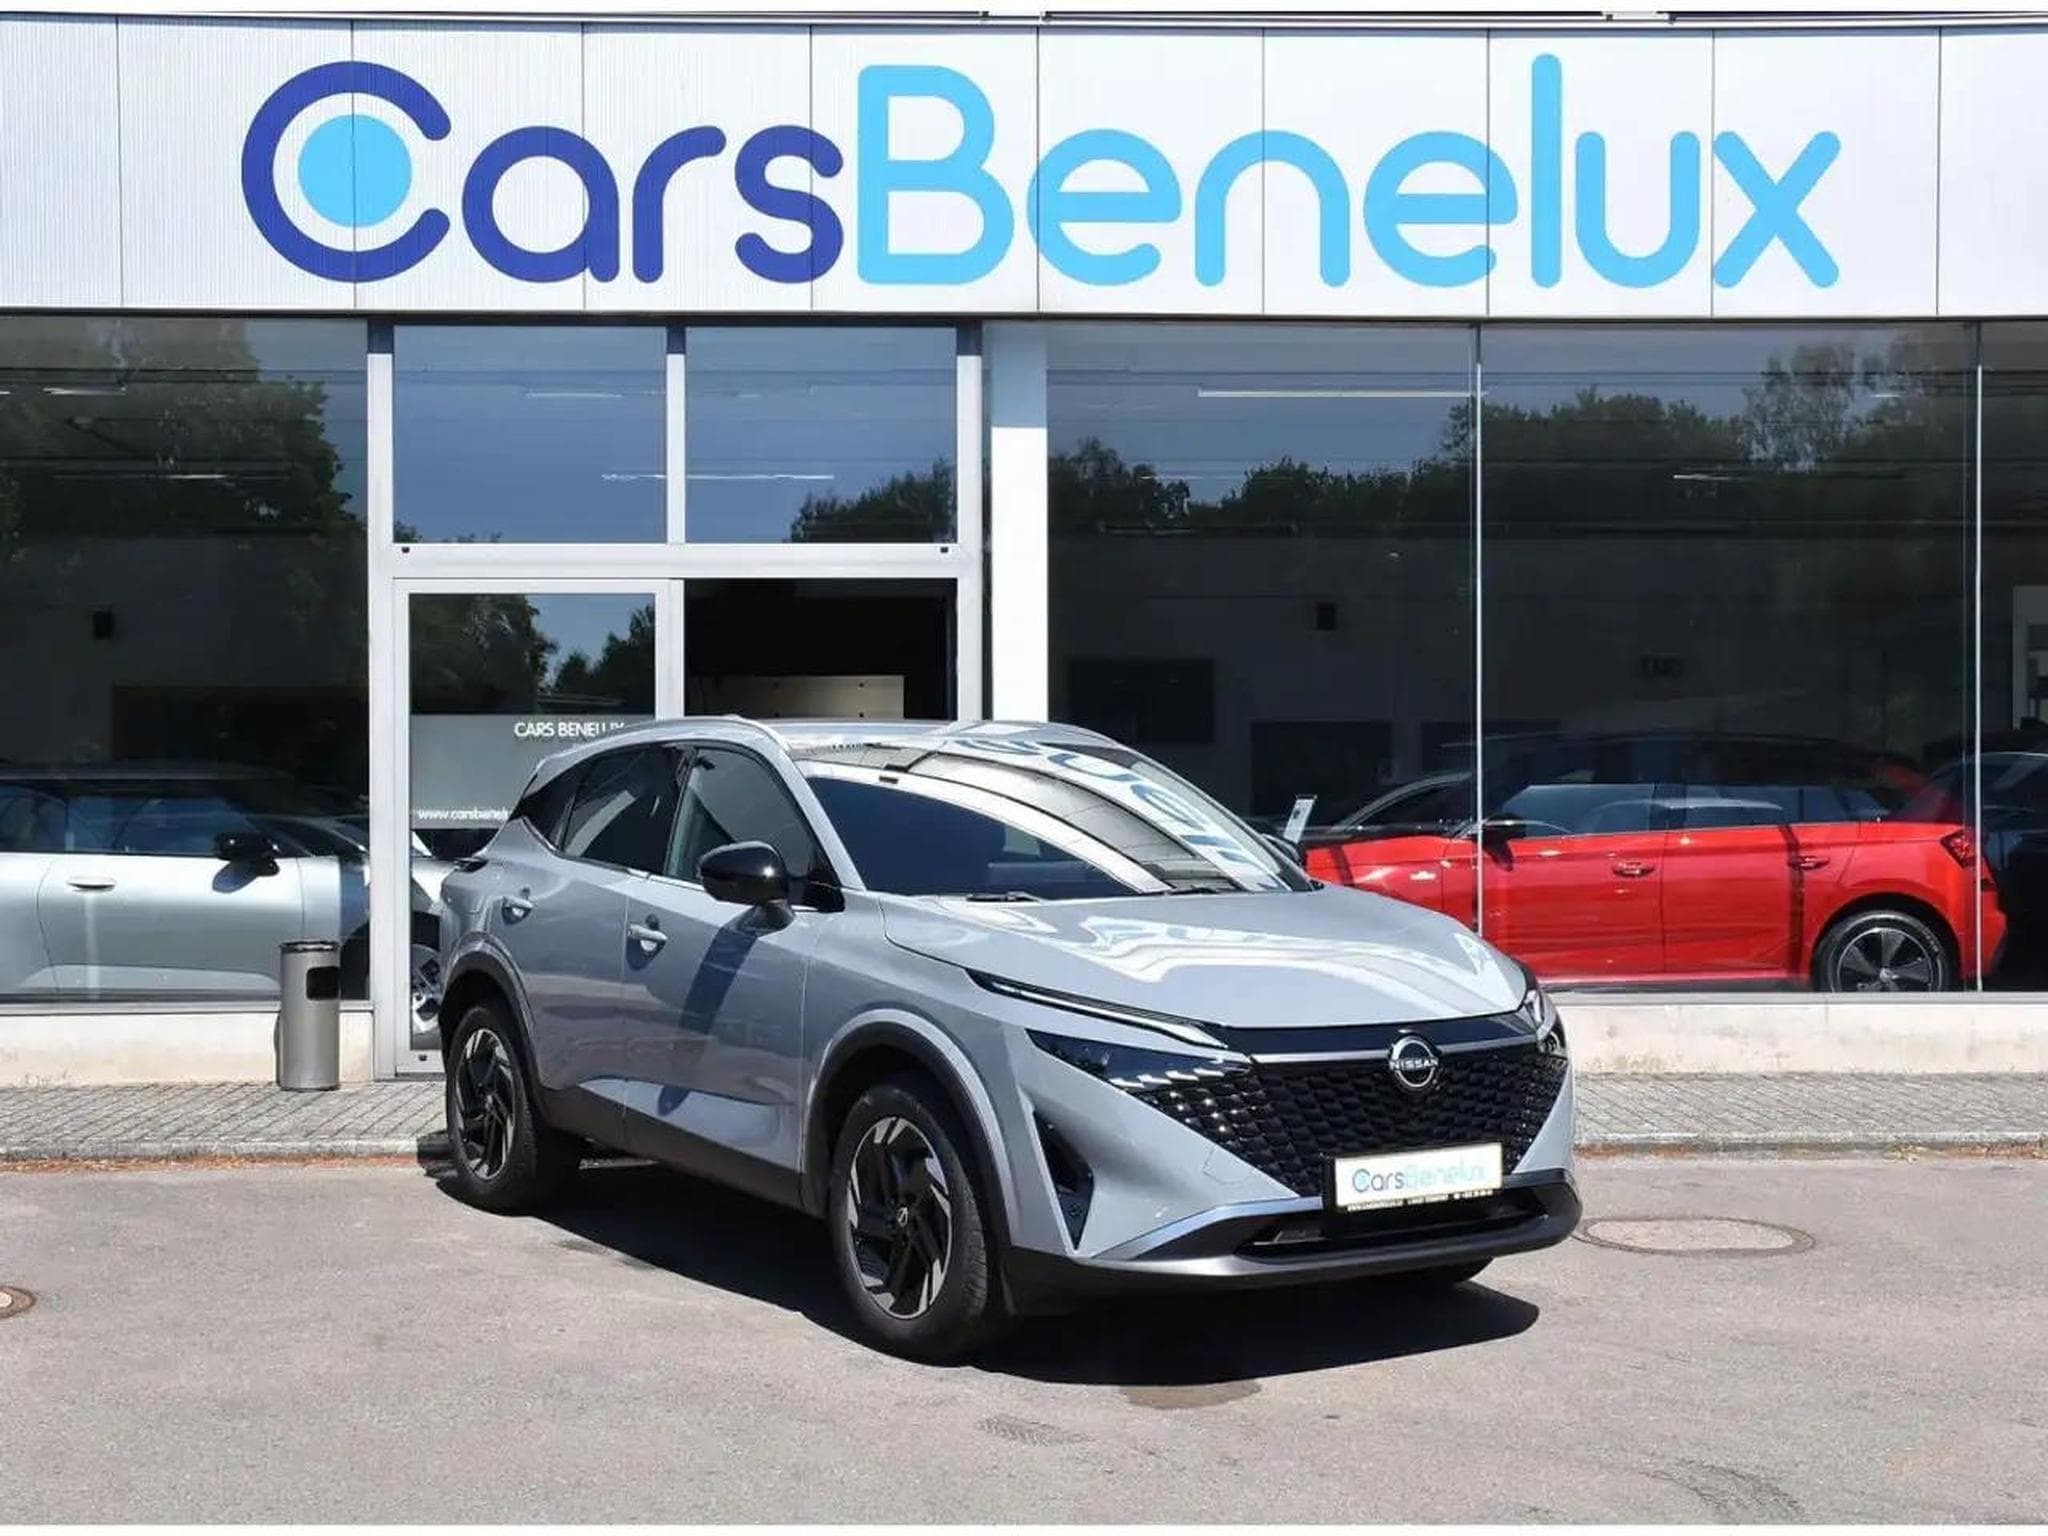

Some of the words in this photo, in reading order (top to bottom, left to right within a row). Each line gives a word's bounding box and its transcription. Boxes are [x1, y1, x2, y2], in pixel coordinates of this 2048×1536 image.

[242, 54, 1841, 288] CarsBenelux
[514, 721, 555, 737] CARS
[418, 806, 508, 820] www.carsbenel
[1389, 1057, 1439, 1071] NISSAN
